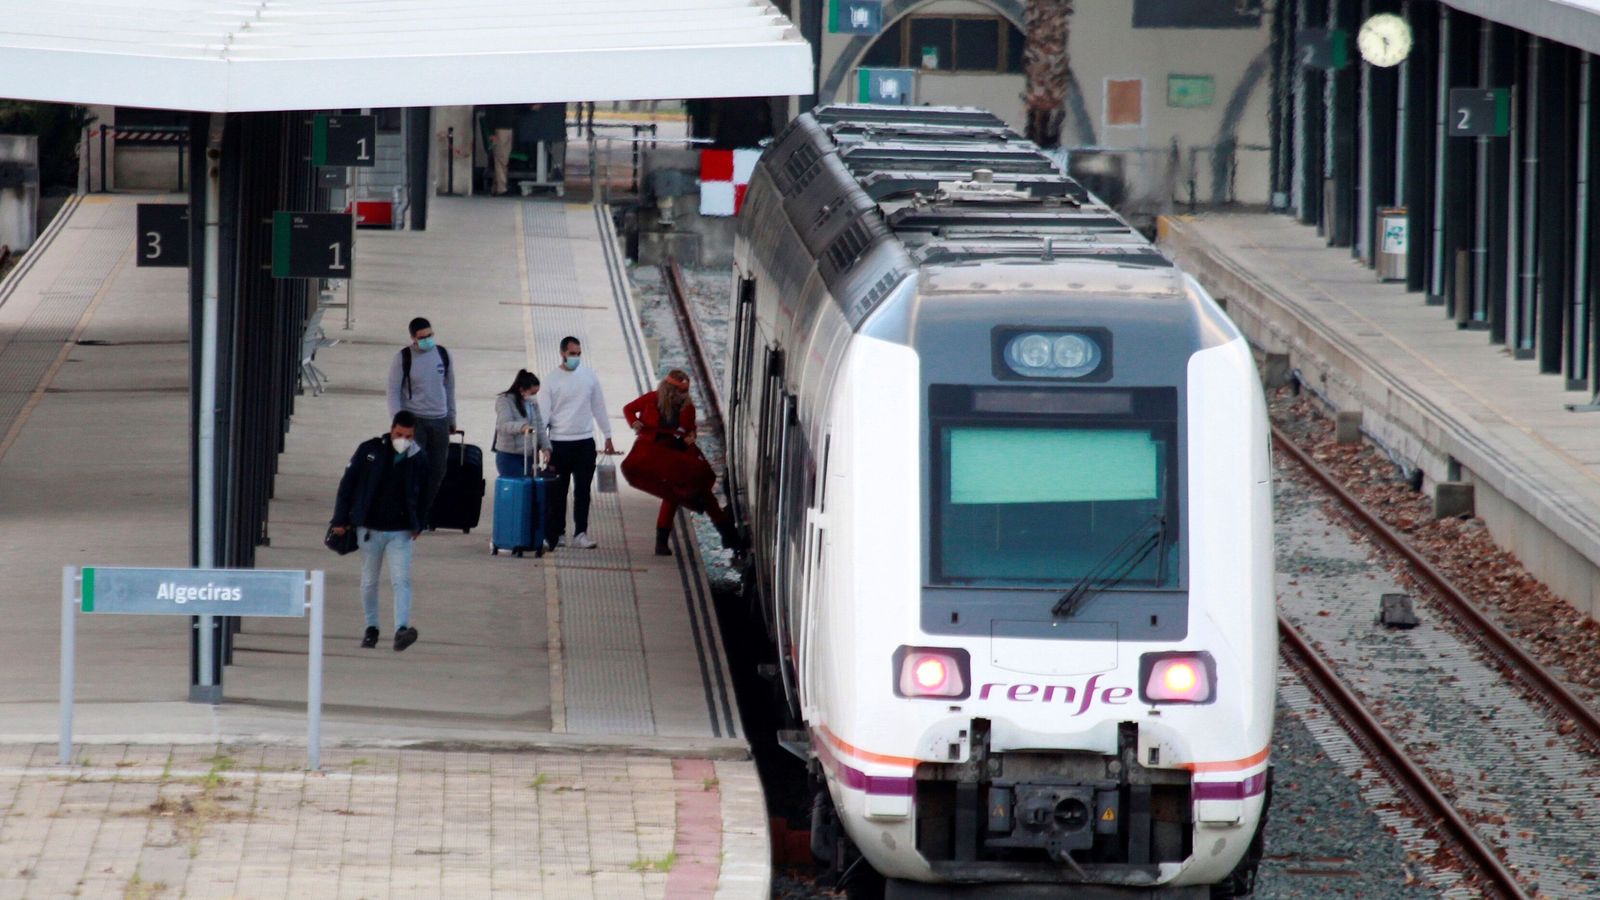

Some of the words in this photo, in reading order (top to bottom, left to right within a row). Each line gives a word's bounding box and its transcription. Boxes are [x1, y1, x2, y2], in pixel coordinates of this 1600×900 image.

[1457, 109, 1469, 129] 2
[356, 138, 370, 160] 1
[146, 232, 161, 258] 3
[328, 242, 345, 270] 1
[157, 582, 242, 604] Algeciras
[978, 673, 1133, 716] renfe
